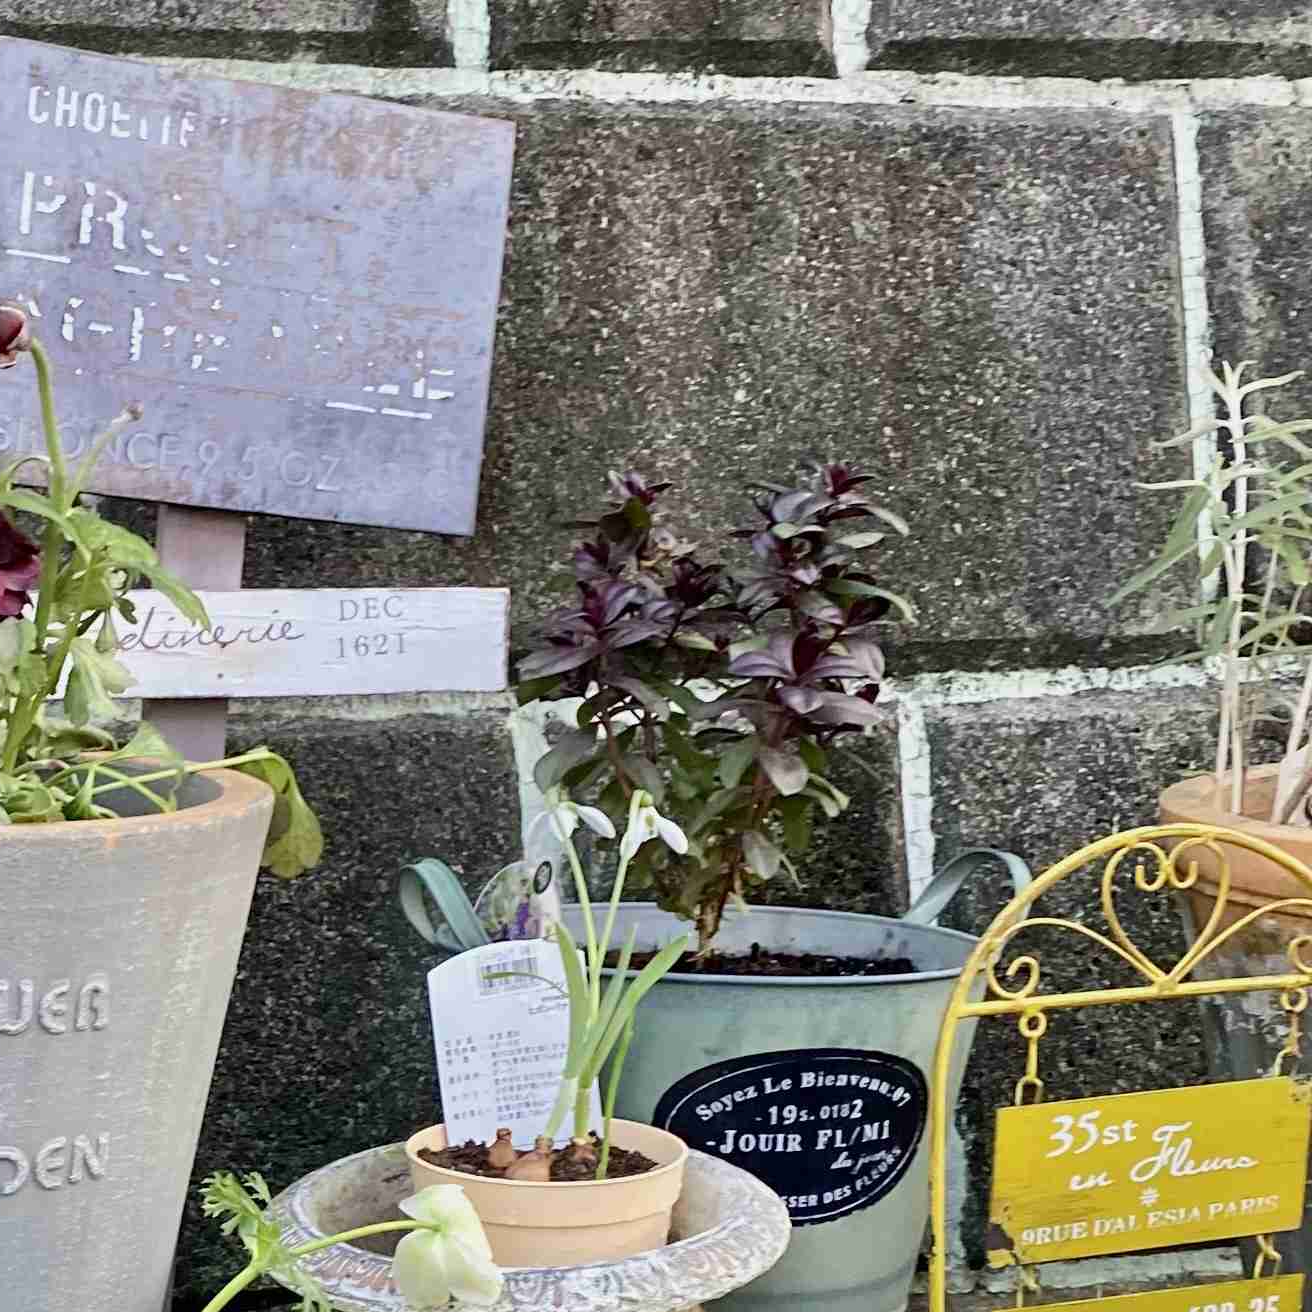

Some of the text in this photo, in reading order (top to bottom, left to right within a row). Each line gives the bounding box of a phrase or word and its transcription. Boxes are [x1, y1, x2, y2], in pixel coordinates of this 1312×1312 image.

[338, 596, 406, 622] DEC
[695, 1085, 759, 1122] Soyez
[762, 1077, 793, 1095] Le
[822, 1185, 853, 1204] DES
[1208, 1194, 1282, 1218] PARIS
